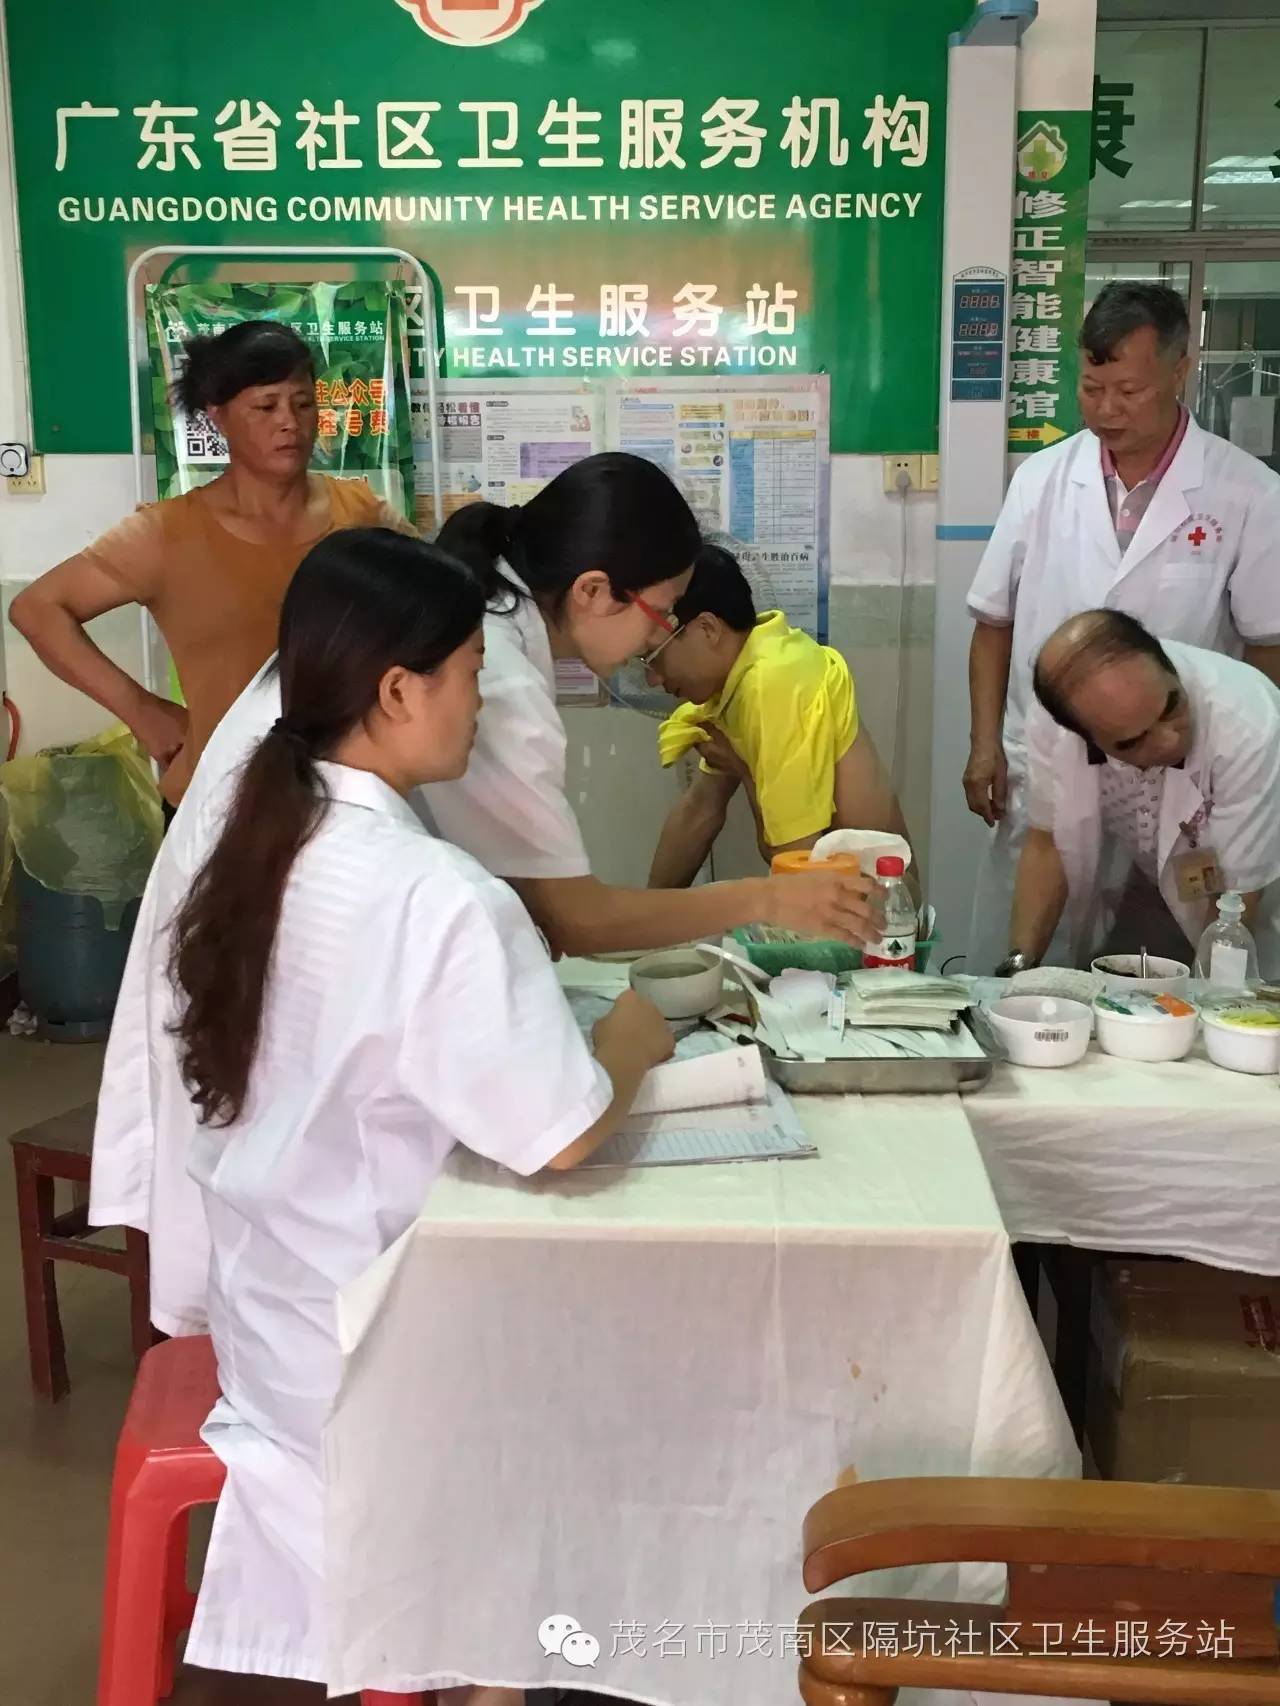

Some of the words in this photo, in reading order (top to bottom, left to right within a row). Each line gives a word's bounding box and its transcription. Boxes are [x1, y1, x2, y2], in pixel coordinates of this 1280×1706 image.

[55, 95, 929, 171] 广东省社区卫生服务机构
[58, 196, 277, 222] GUANGDONG
[287, 196, 494, 222] COMMUNITY
[503, 195, 630, 221] HEALTH
[639, 194, 776, 221] SERVICE
[785, 193, 922, 219] AGENCY
[453, 347, 556, 368] HEALTH
[562, 346, 674, 368] SERVICE
[680, 345, 798, 367] STATION
